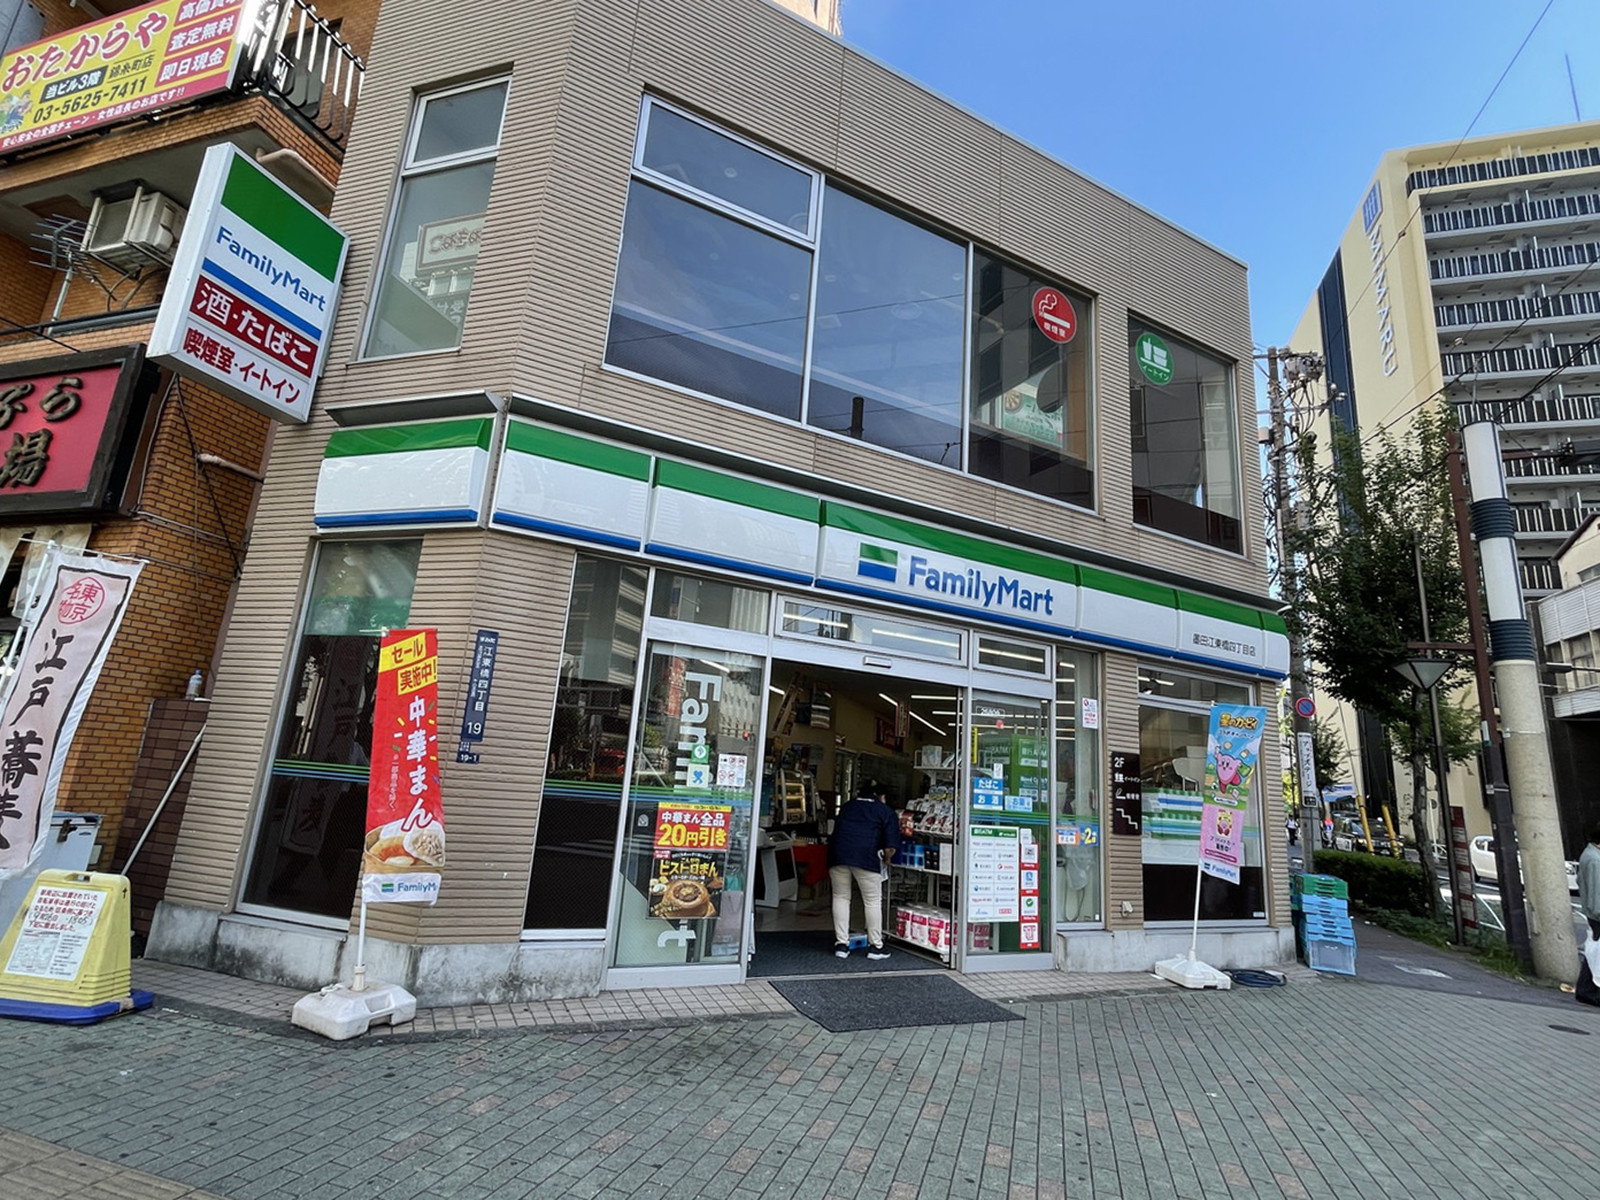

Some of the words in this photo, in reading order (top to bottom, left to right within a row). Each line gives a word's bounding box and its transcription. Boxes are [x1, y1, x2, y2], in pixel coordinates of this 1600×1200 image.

[179, 0, 236, 21] 高価買
[168, 15, 234, 52] 査定無料
[1, 12, 168, 92] おたからや
[160, 47, 225, 82] 即日現金
[108, 56, 154, 80] 錦糸町店
[33, 77, 147, 123] 03-5625-7411
[45, 73, 102, 100] 当ビル3階
[217, 226, 326, 311] FamilyMart
[197, 283, 311, 370] 酒・たばこ
[183, 328, 300, 404] 喫煙室・イートイン
[1142, 364, 1169, 381] イートイン
[909, 555, 1053, 615] FamilyMart
[392, 638, 423, 664] セール
[400, 659, 437, 691] 実施中!
[474, 646, 493, 711] 江東橋四丁目
[467, 722, 482, 735] 19
[401, 695, 433, 832] 中華まん
[460, 754, 477, 762] 19-1
[1114, 757, 1125, 767] 2F
[662, 811, 725, 826] 中華まん全品
[657, 823, 727, 847] 20円引き
[659, 859, 718, 878] ビストロまん
